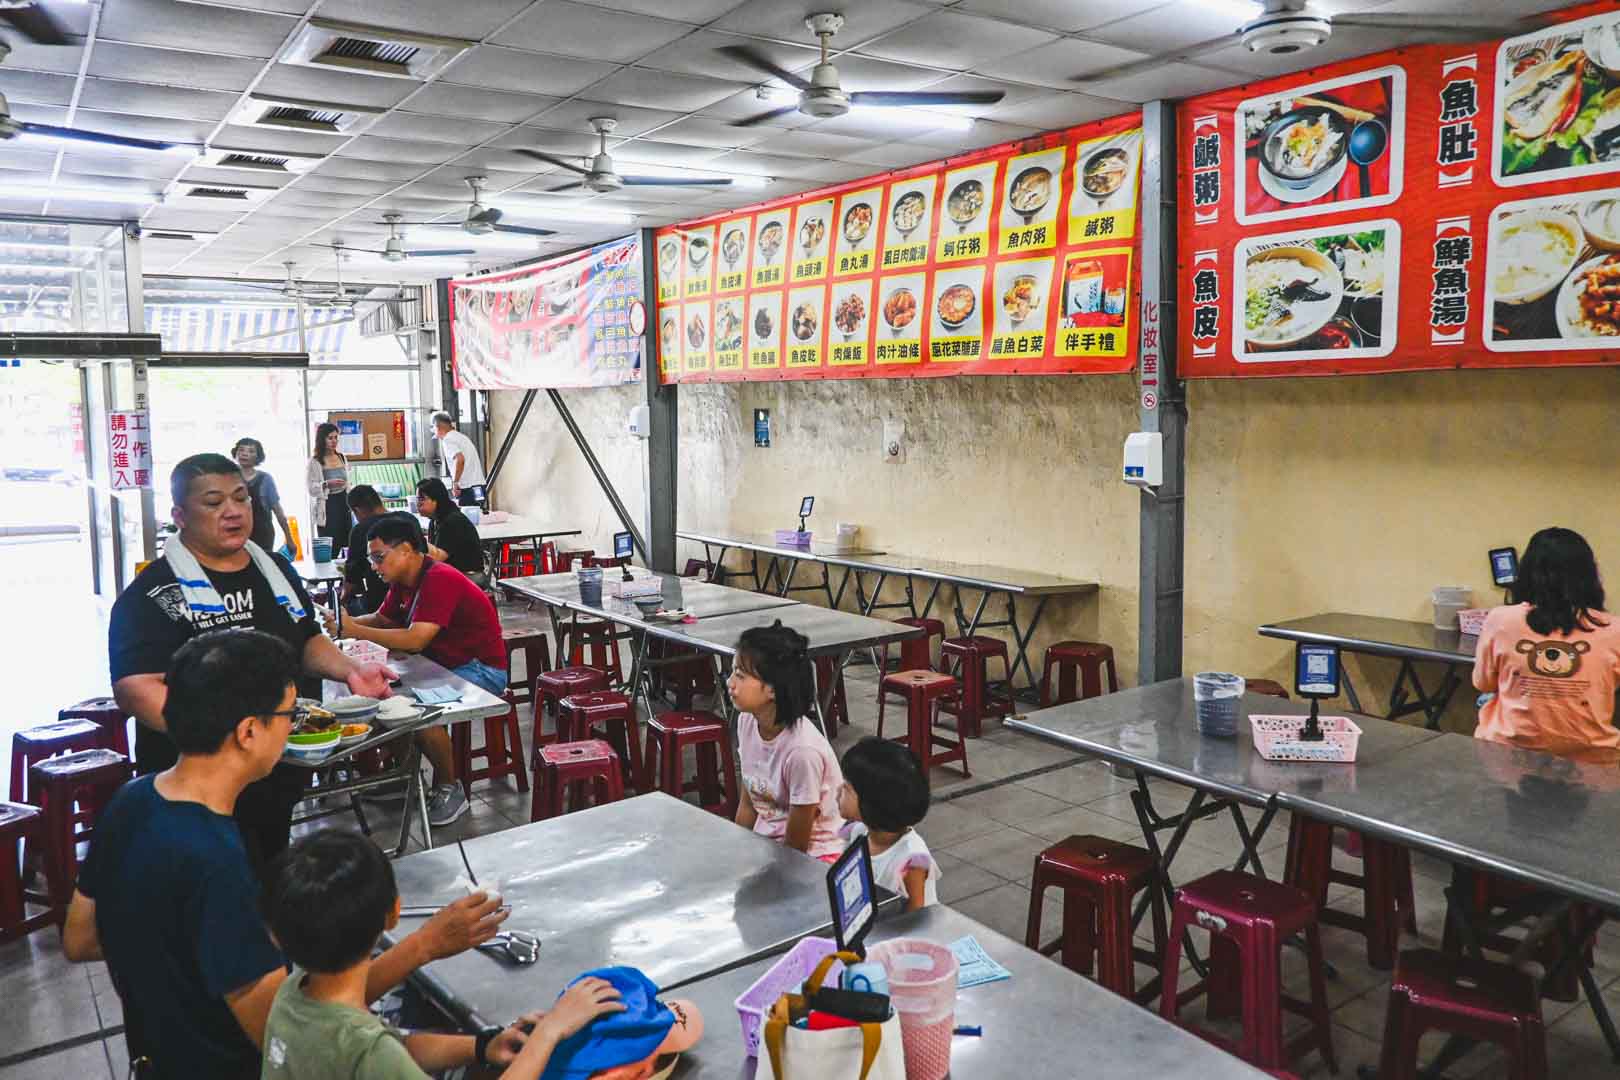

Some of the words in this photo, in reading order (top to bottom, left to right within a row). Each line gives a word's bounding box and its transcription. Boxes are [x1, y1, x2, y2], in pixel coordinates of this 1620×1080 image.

[1438, 80, 1476, 164] 魚肚
[1193, 135, 1220, 205] 鹹粥
[944, 237, 981, 257] 蚵仔粥
[1007, 228, 1047, 248] 魚肉粥
[1084, 216, 1115, 237] 鹹粥
[840, 254, 869, 272] 魚丸湯
[1431, 238, 1471, 325] 鮮魚湯
[1192, 269, 1219, 340] 魚皮
[877, 343, 920, 360] 肉汁油條
[1064, 333, 1116, 351] 伴手禮
[1143, 301, 1158, 375] 化妝室
[111, 414, 130, 487] 請勿進入
[130, 414, 150, 486] 工作區
[215, 615, 230, 625] GET
